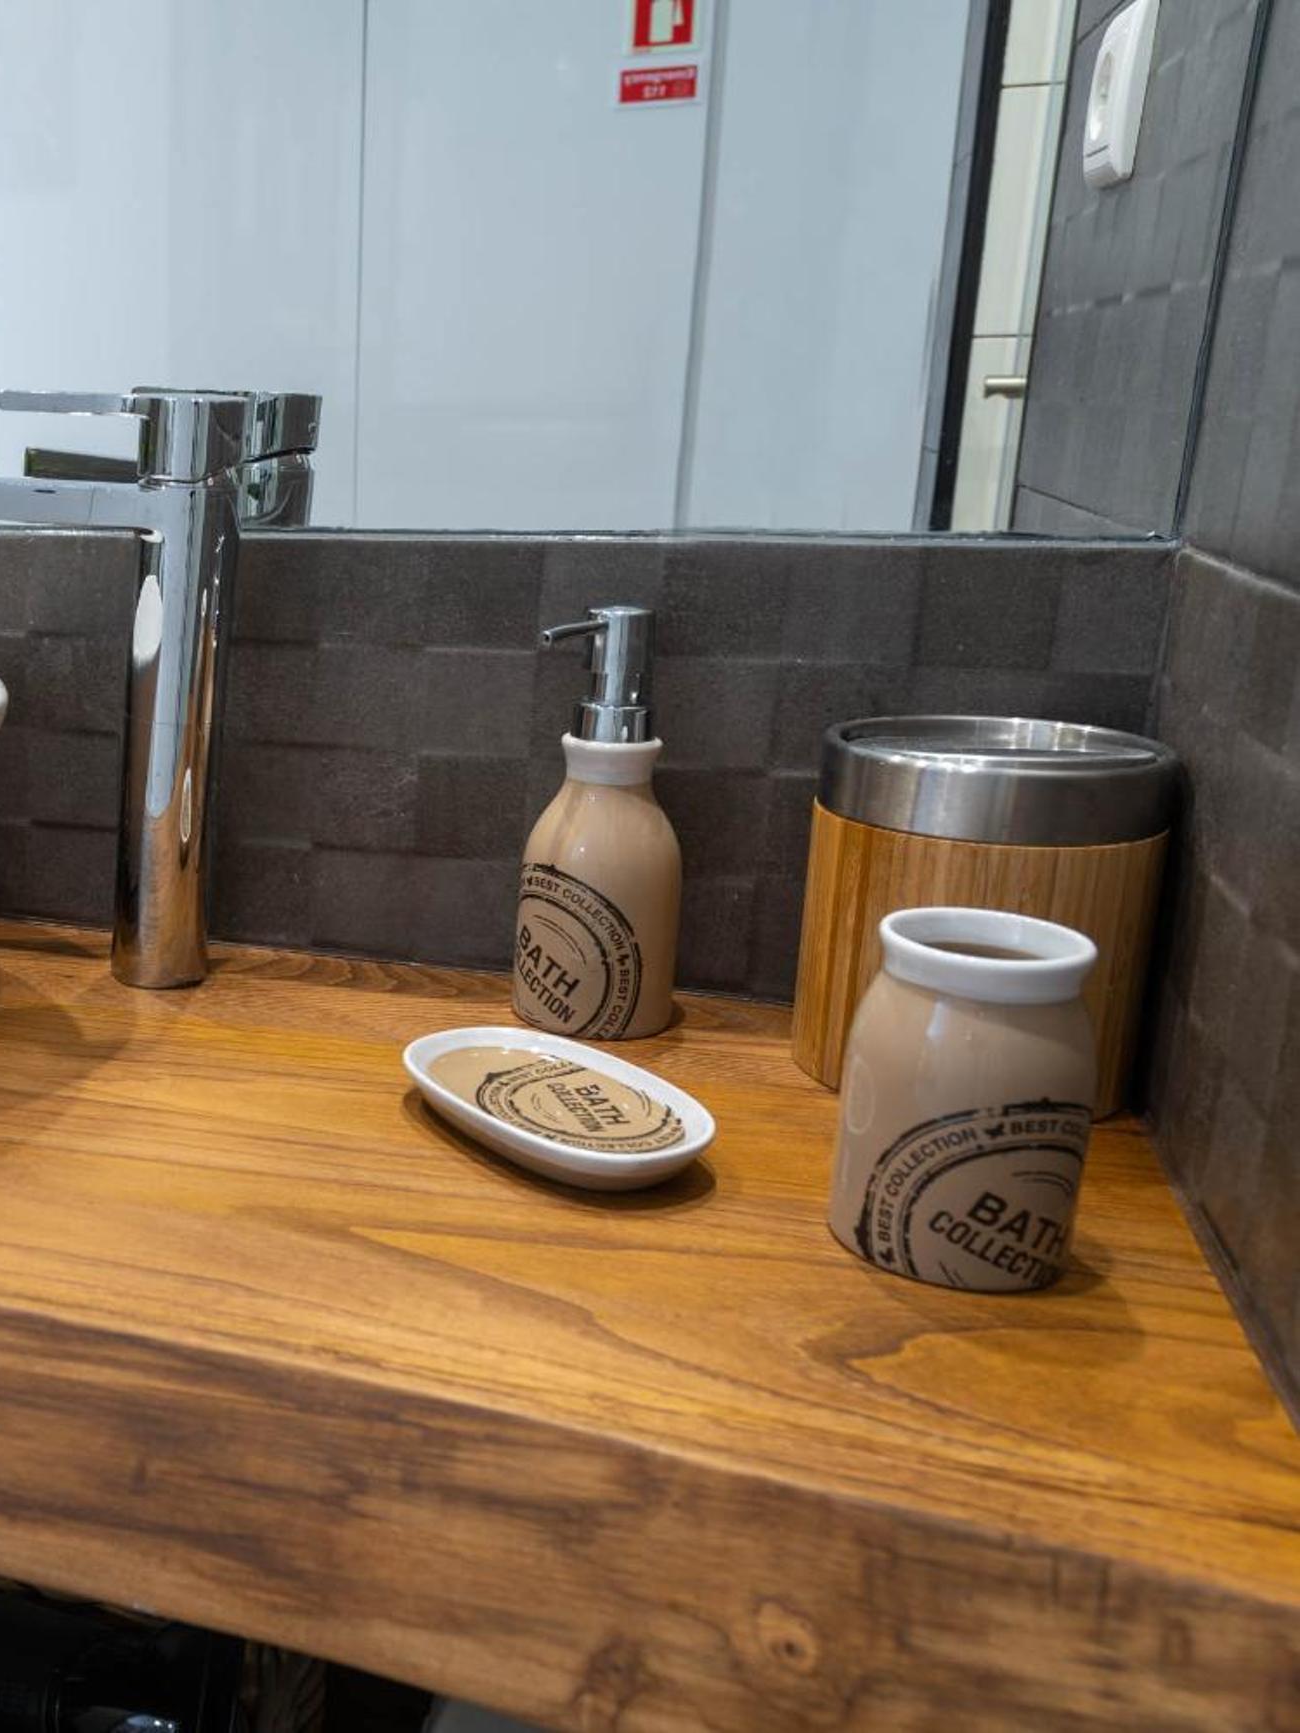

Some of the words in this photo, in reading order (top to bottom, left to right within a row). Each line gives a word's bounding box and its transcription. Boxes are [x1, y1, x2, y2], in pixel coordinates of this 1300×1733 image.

[562, 888, 627, 951] COLLECTION
[520, 925, 581, 998] BATH
[547, 1082, 605, 1132] COLLECTION
[573, 1083, 632, 1126] BATH
[1010, 1119, 1058, 1135] BEST
[885, 1128, 978, 1197] COLLECTION
[877, 1196, 895, 1242] BEST
[967, 1191, 1067, 1258] BATH
